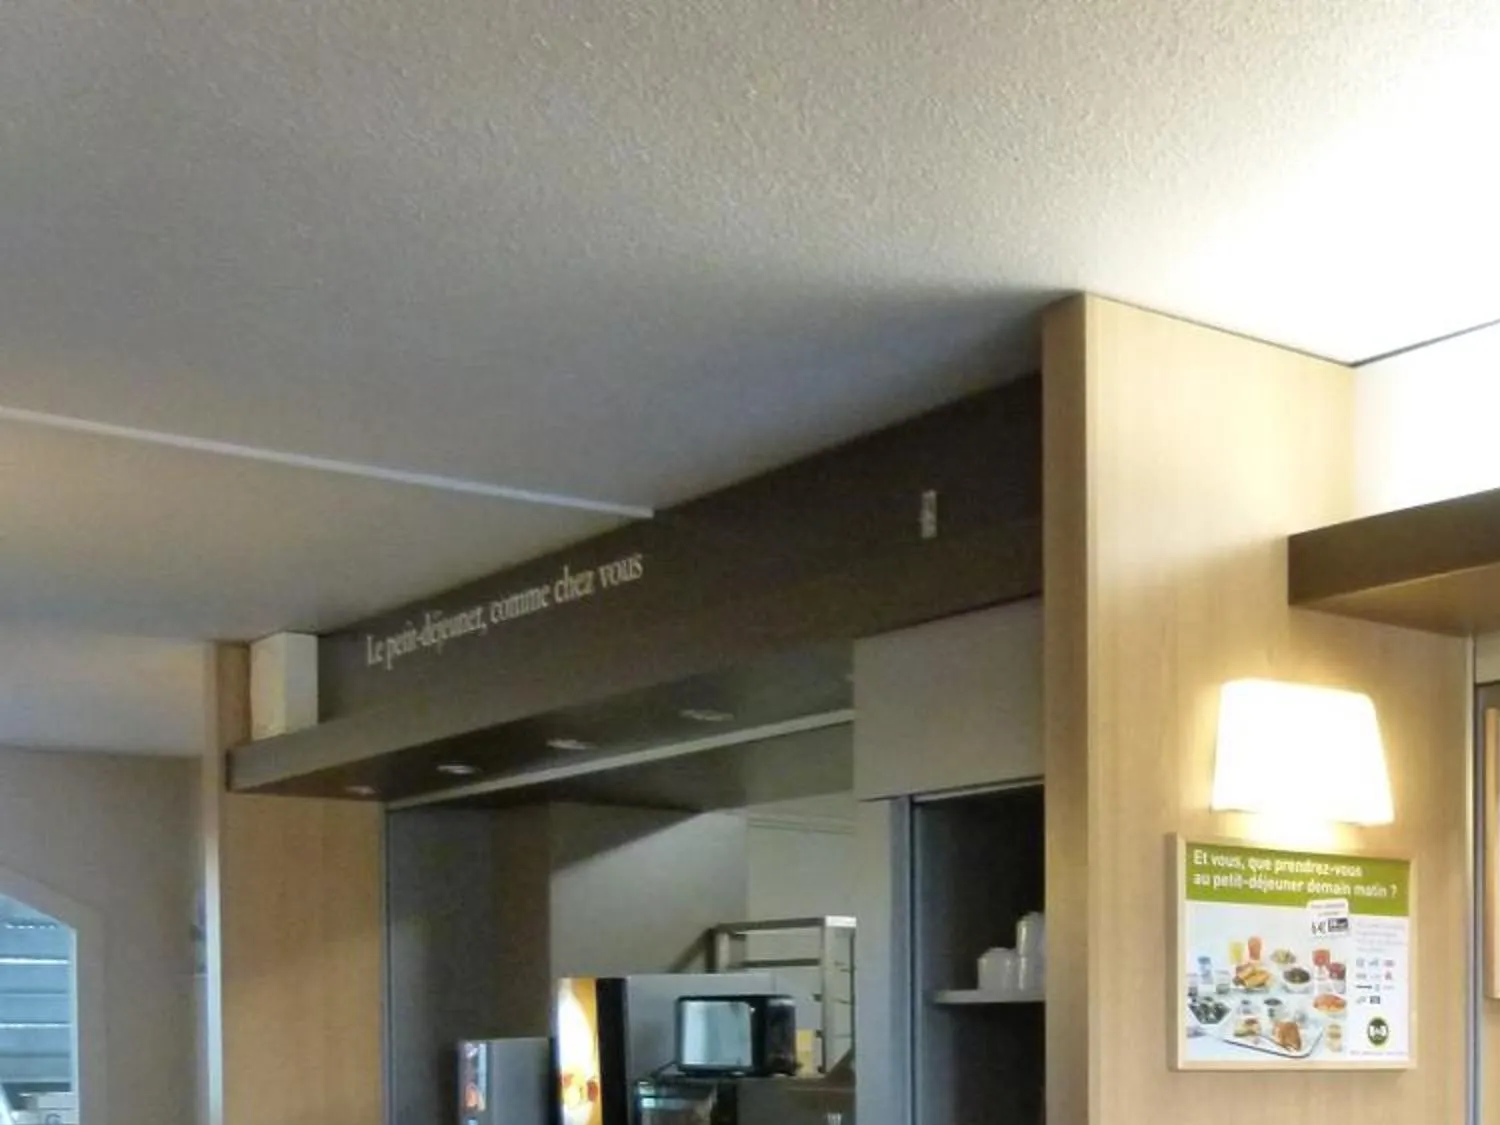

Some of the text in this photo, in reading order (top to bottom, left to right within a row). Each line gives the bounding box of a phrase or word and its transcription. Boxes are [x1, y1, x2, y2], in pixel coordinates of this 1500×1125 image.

[366, 634, 383, 666] Le
[490, 584, 550, 624] comme
[554, 564, 594, 604] chez
[599, 552, 644, 589] vous
[1193, 848, 1208, 866] Et
[1248, 856, 1274, 874] que
[1275, 857, 1364, 878] prendrez-vous
[1193, 873, 1210, 885] au
[1213, 872, 1304, 894] petit-déjeuner
[1306, 878, 1352, 894] demain
[1353, 882, 1389, 898] matin
